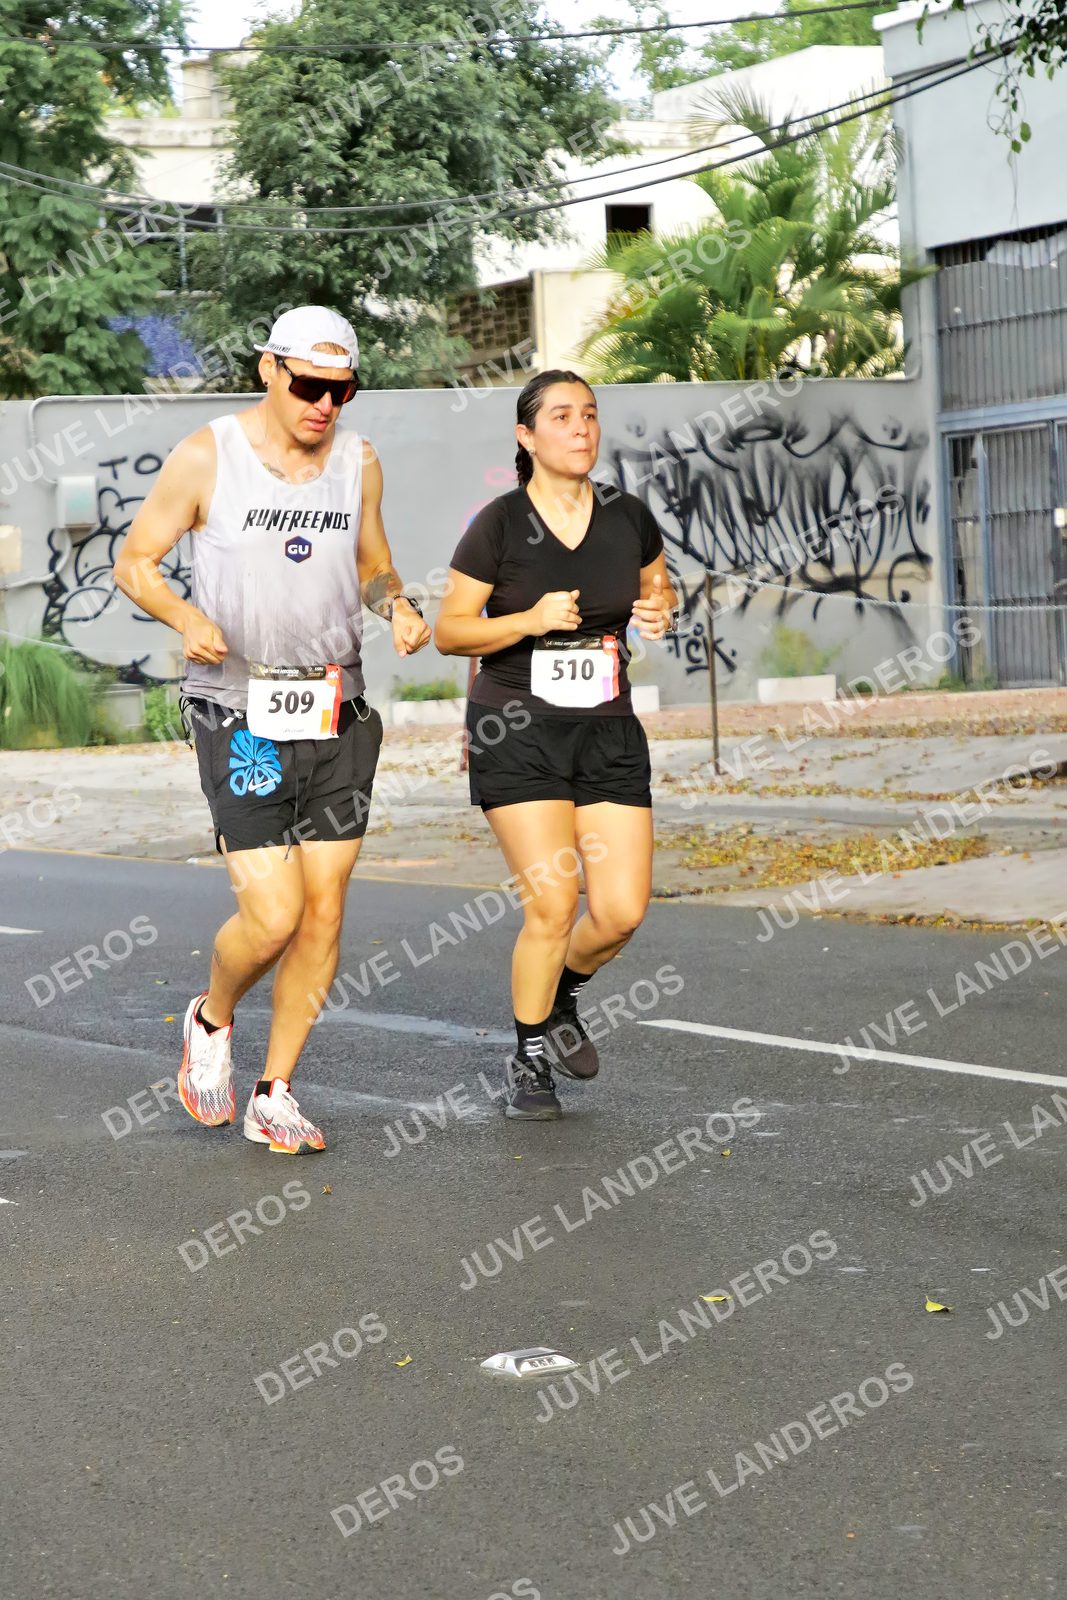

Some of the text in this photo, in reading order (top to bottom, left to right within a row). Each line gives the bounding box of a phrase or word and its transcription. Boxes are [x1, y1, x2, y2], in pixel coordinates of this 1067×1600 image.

[242, 509, 351, 532] RUNFREENDS
[287, 544, 309, 555] GU
[551, 658, 594, 681] 510
[268, 690, 315, 715] 509
